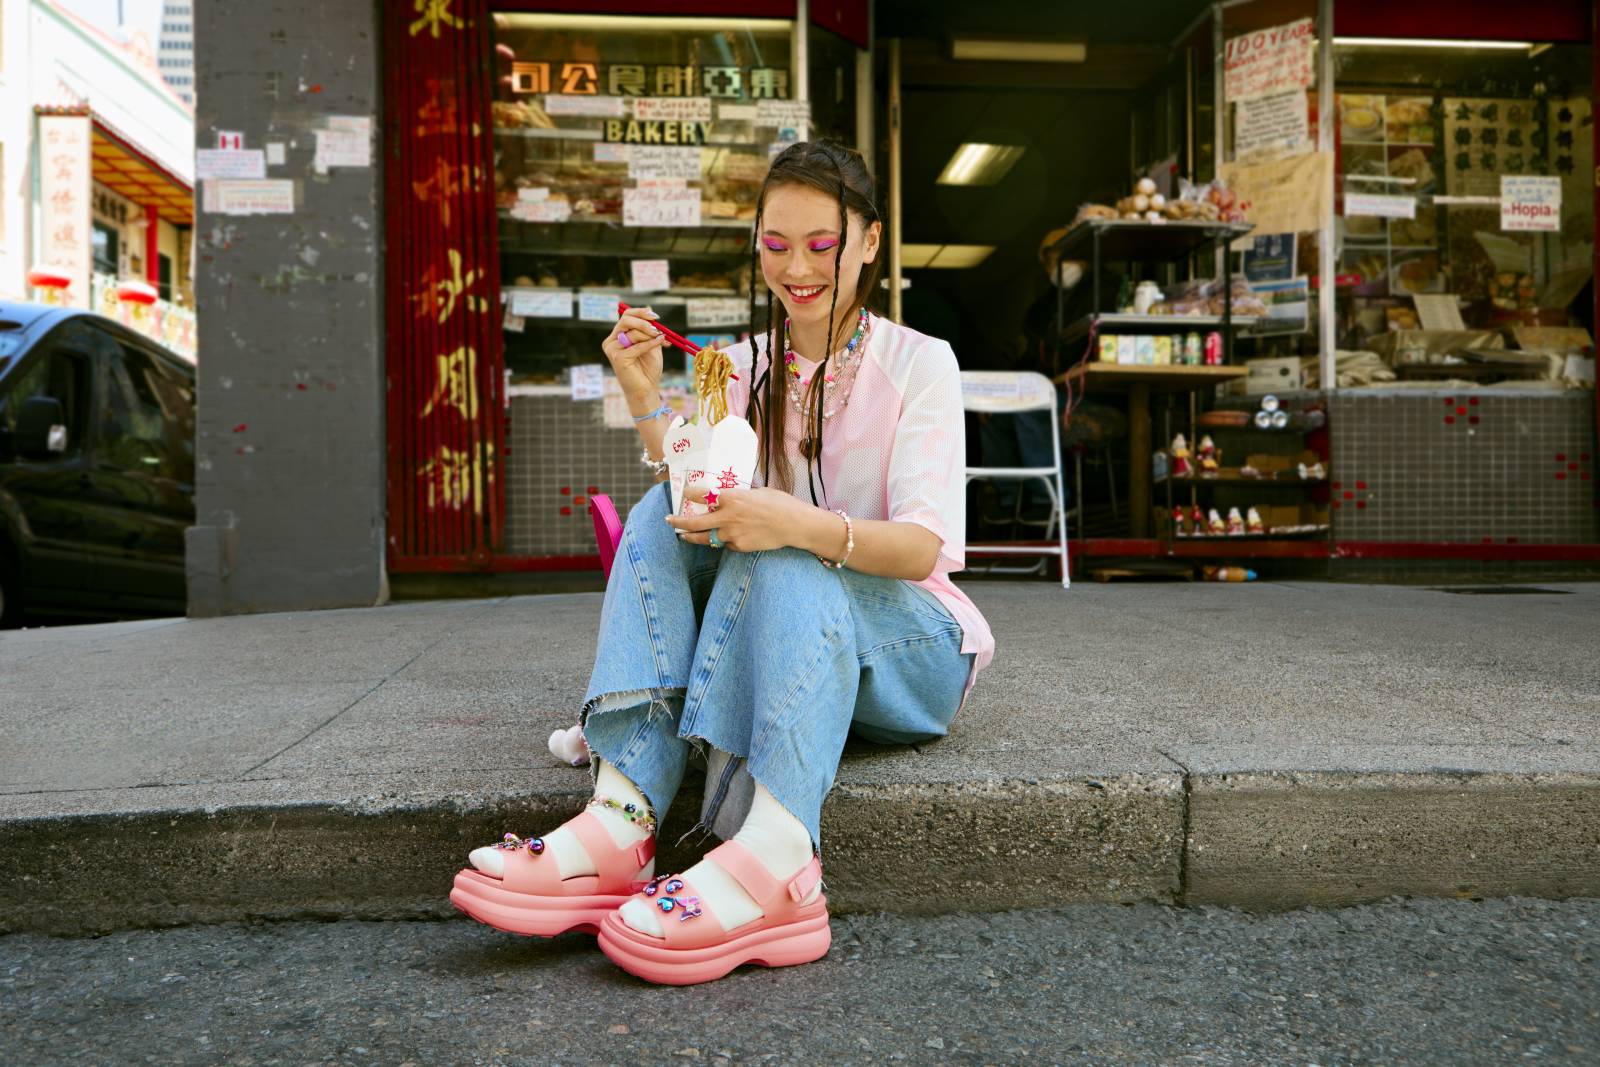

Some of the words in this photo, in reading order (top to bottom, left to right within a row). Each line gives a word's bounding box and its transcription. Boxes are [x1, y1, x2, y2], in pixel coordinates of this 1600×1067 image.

[606, 119, 714, 143] BAKERY
[1511, 202, 1551, 219] Hopia
[672, 438, 691, 453] Enjoy
